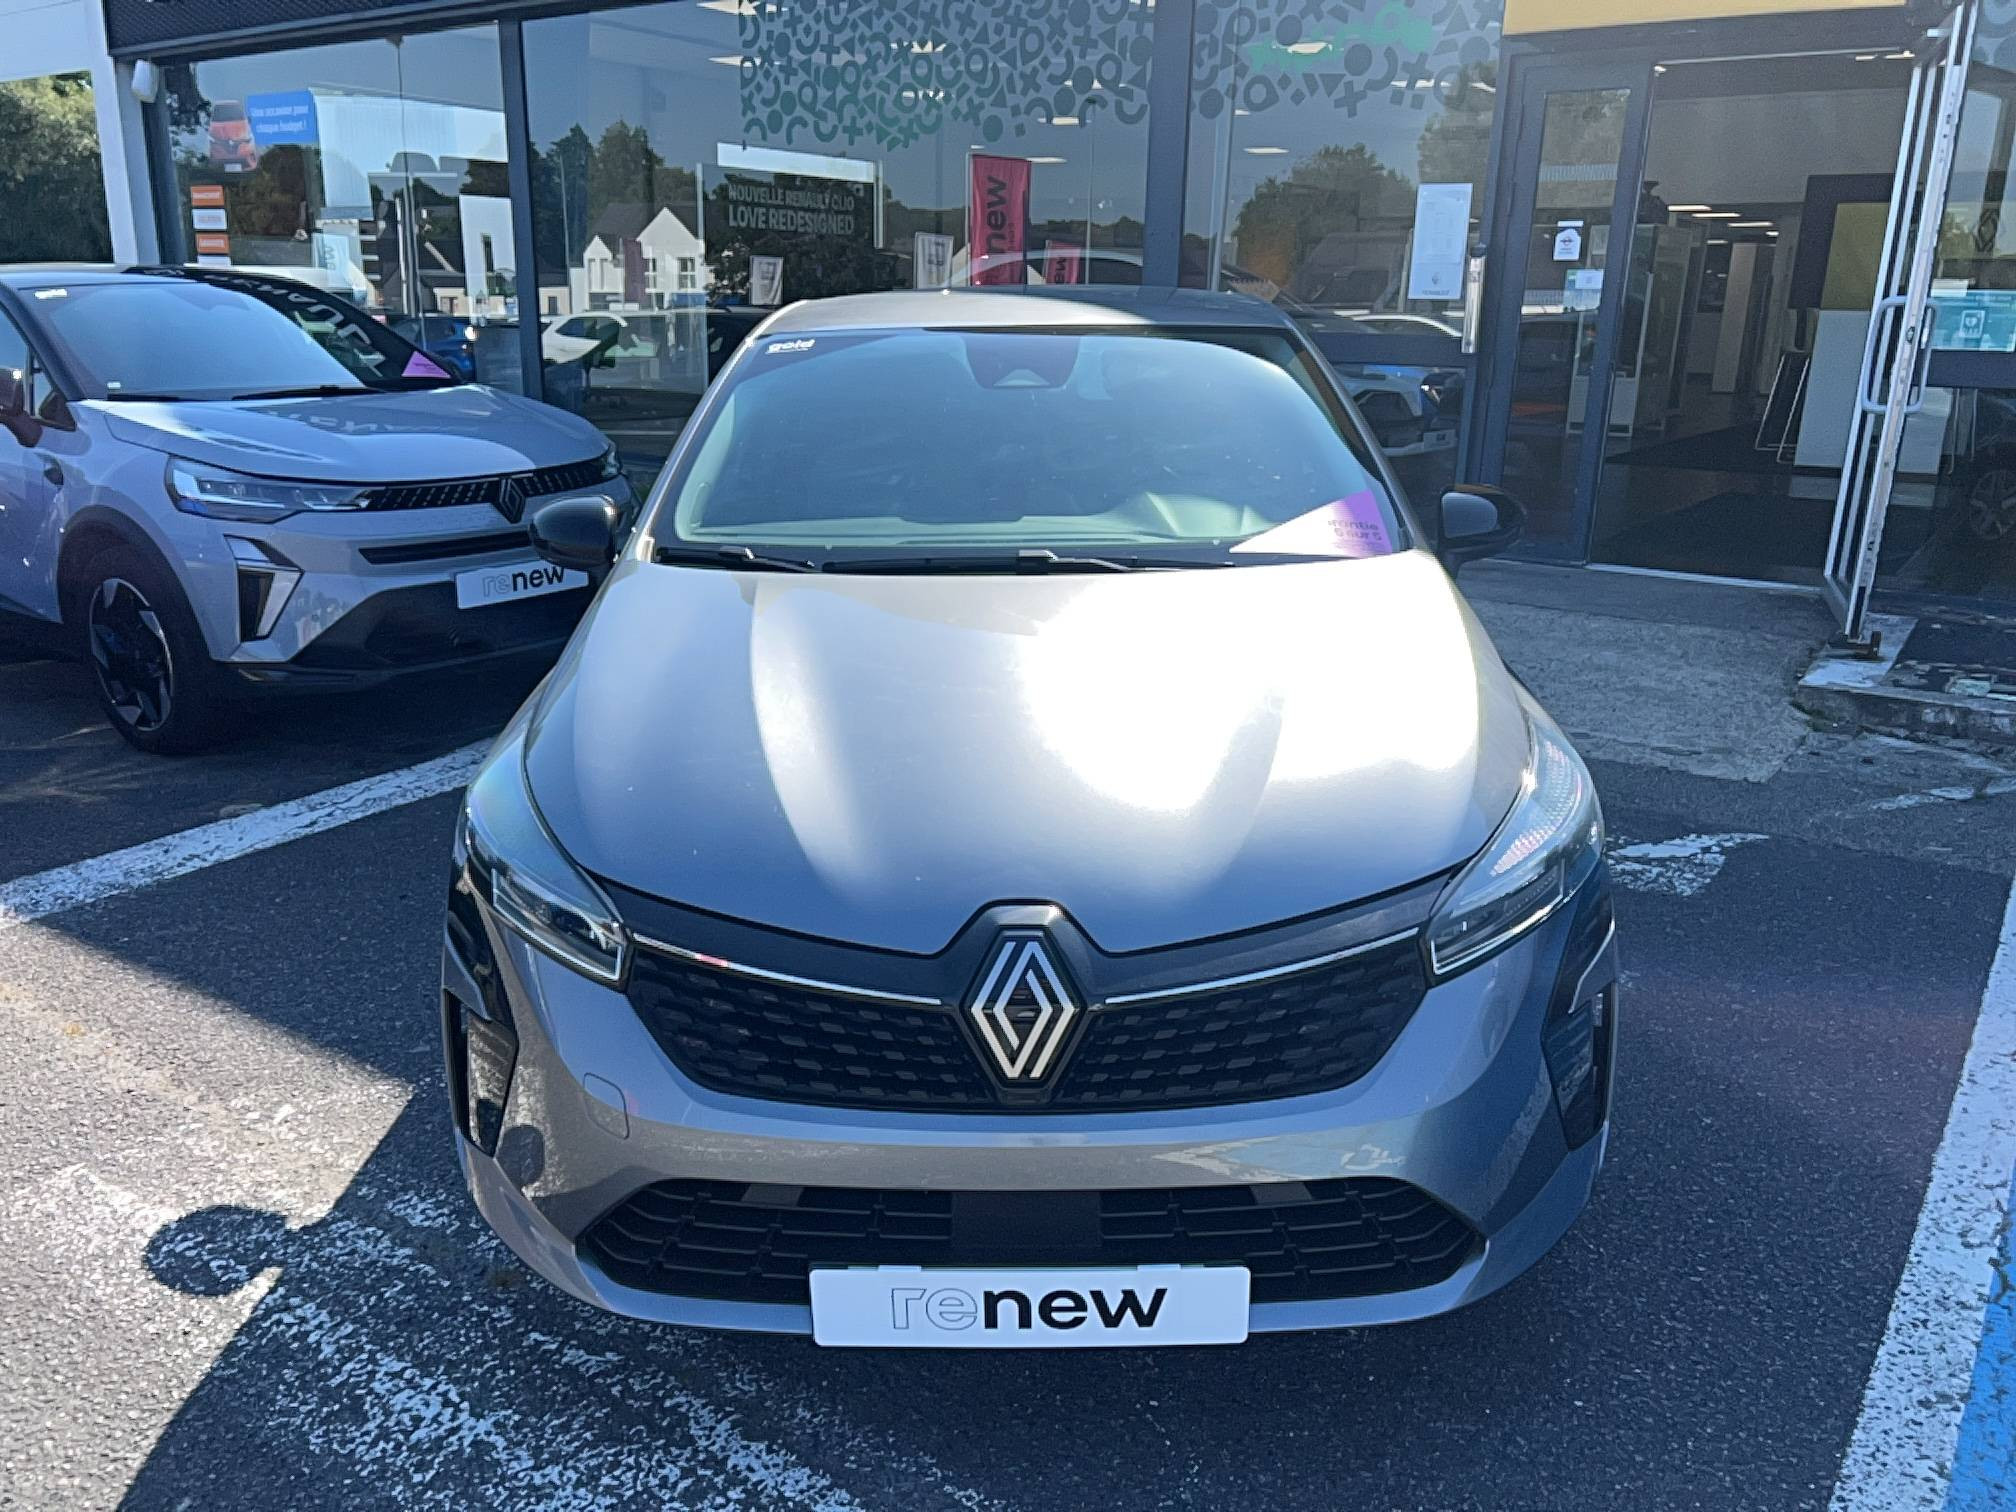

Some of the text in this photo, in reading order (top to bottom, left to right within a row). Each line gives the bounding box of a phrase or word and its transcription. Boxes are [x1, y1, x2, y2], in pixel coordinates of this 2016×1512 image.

[728, 183, 784, 205] NOUVELLE
[728, 204, 855, 234] LOVE REDESIGNED
[481, 566, 565, 598] renew
[890, 1287, 1168, 1330] renew
